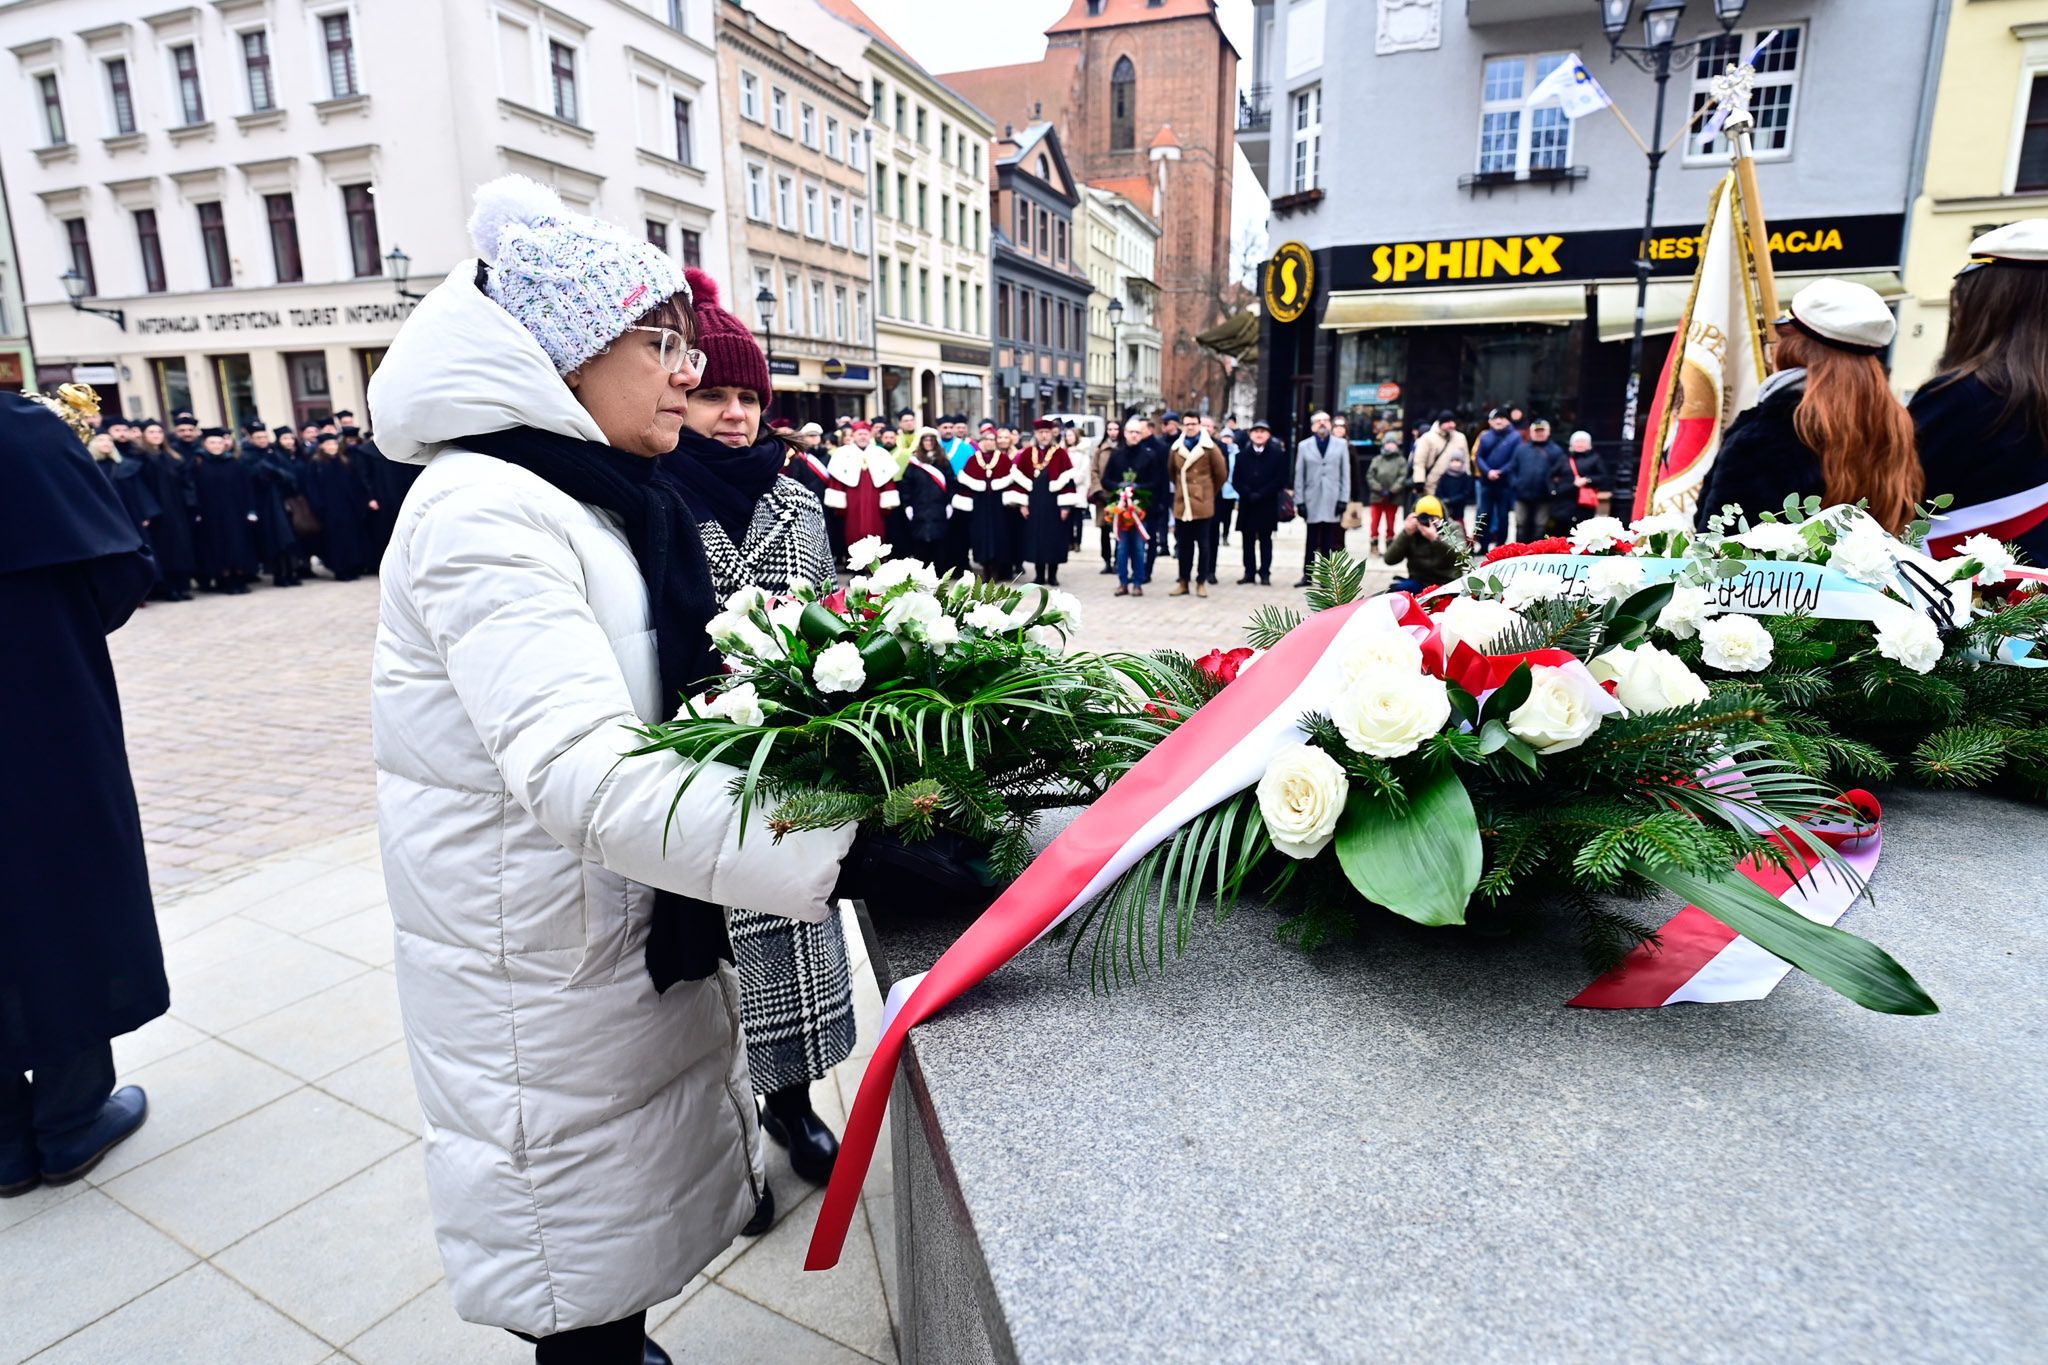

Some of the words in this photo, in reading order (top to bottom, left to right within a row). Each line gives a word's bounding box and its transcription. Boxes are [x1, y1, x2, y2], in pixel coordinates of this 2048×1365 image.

[1371, 235, 1565, 283] SPHINX
[136, 315, 200, 335] INFORMACJA
[206, 310, 281, 332] TURYSTYCZNA
[289, 306, 337, 327] TOURIST
